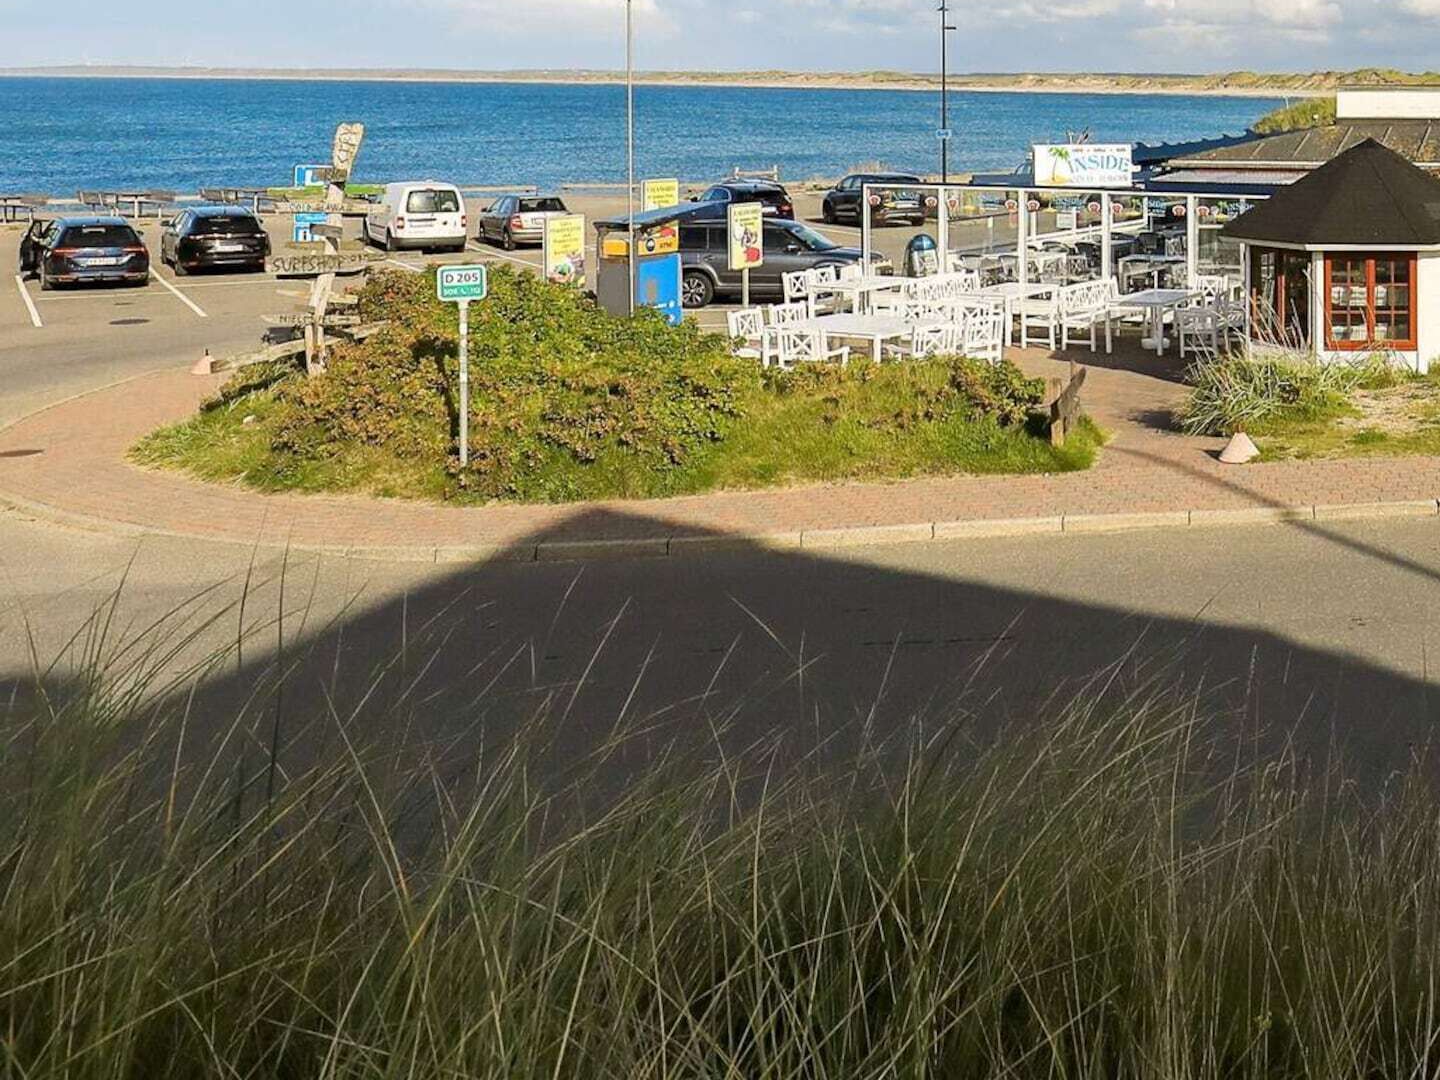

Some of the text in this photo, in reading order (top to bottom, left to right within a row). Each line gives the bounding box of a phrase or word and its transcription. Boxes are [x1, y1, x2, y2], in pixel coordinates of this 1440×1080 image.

[1067, 155, 1130, 172] INSIDE
[445, 272, 479, 283] D 205
